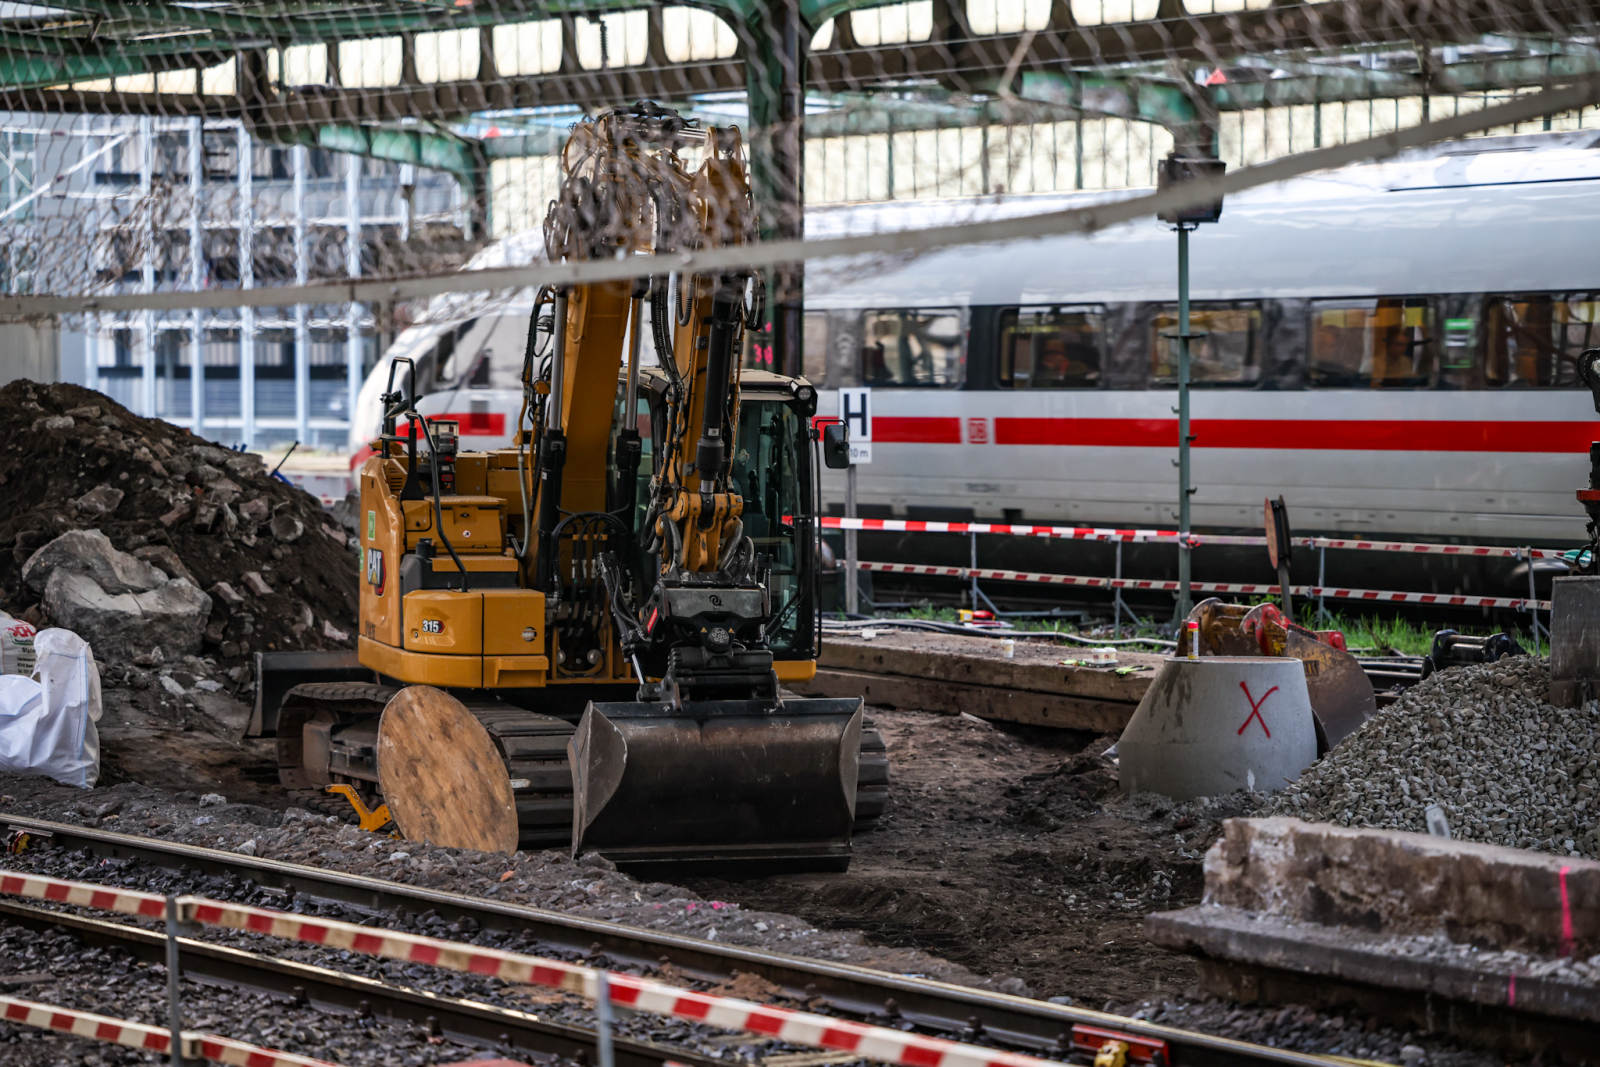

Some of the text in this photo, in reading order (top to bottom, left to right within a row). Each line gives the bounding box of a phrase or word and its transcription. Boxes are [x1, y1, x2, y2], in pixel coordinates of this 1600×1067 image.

[844, 393, 867, 436] H
[368, 548, 382, 585] CAT
[422, 619, 439, 633] 315
